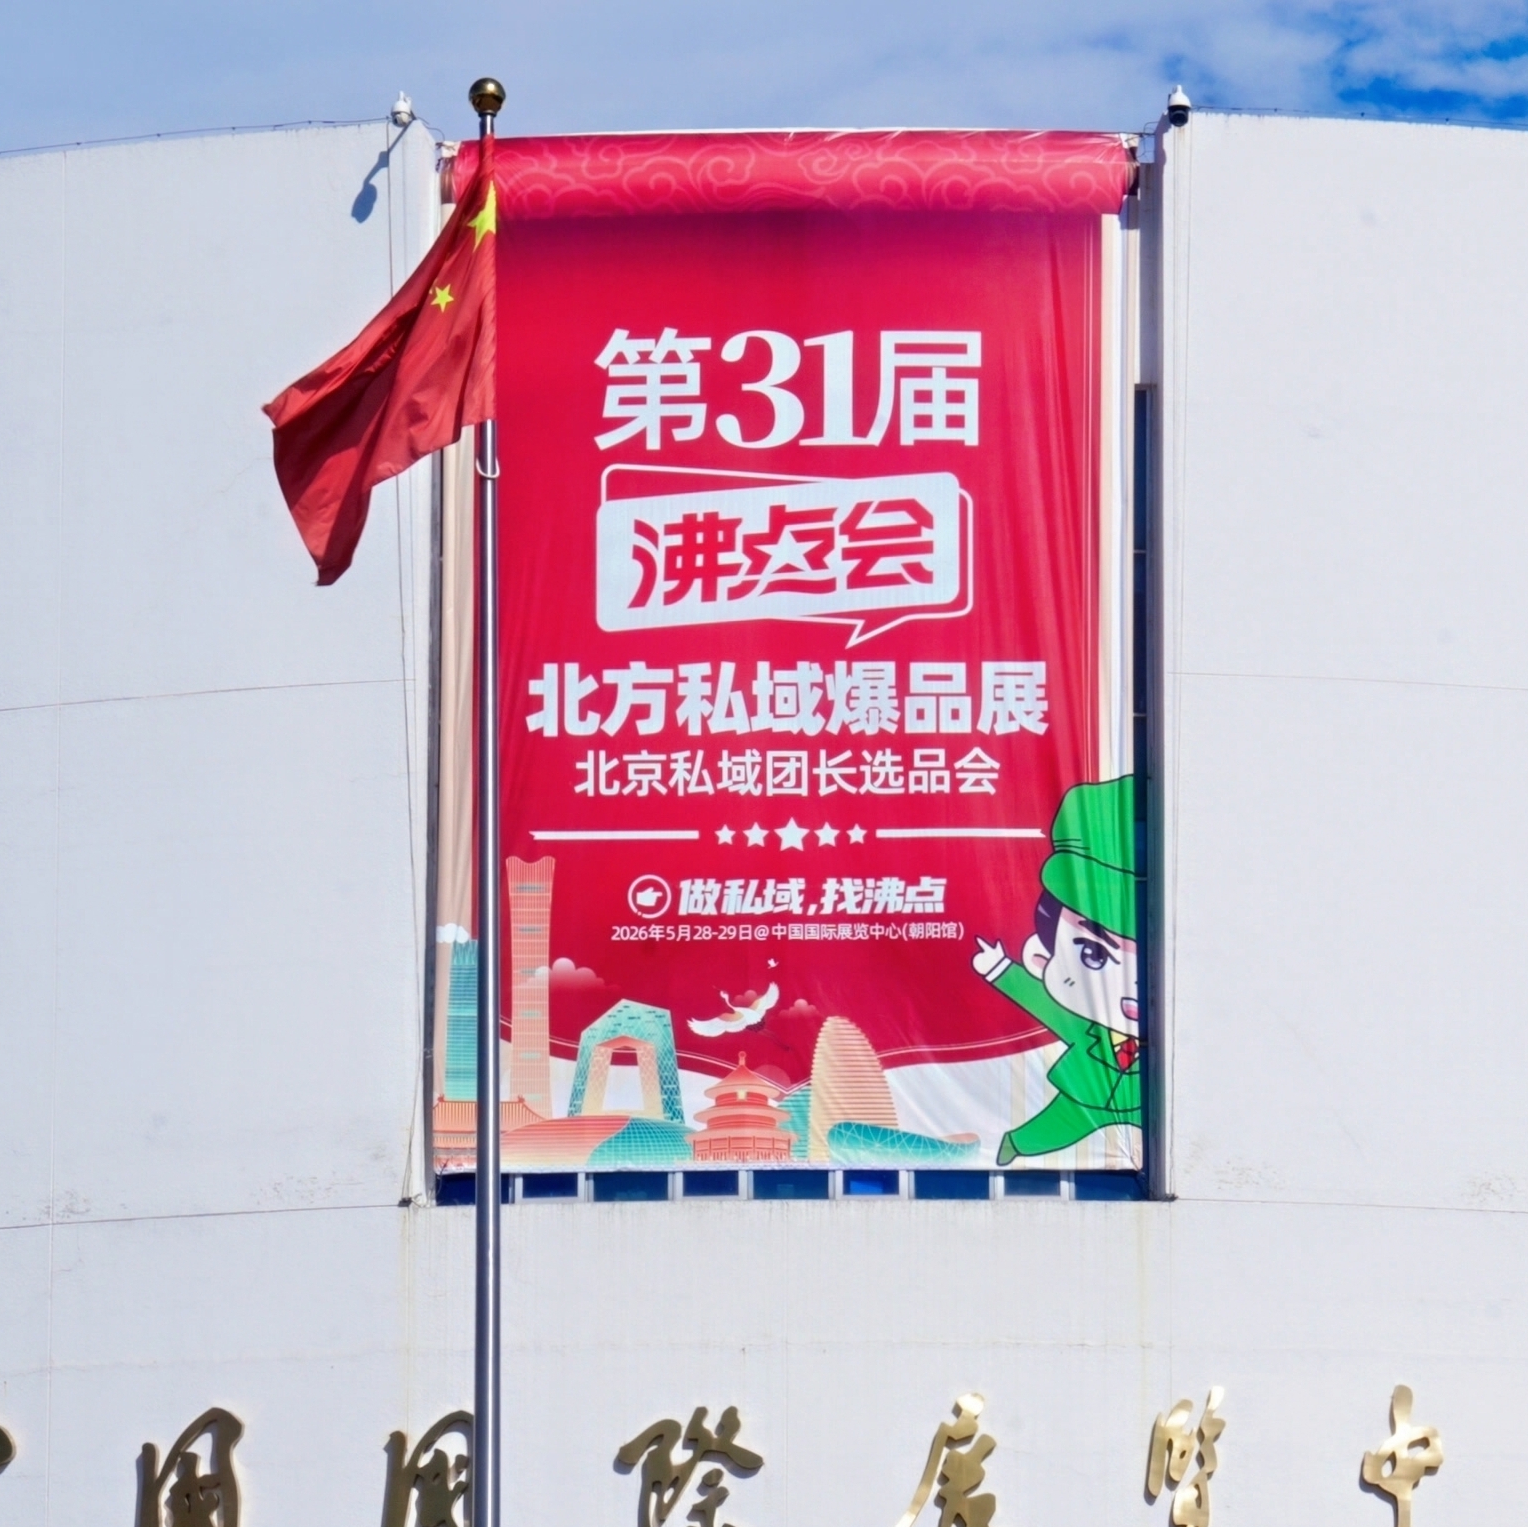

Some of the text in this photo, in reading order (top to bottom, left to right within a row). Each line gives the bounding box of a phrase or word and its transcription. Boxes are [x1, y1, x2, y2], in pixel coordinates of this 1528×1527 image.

[593, 327, 982, 451] 第31届
[628, 498, 935, 610] 沸点会
[525, 661, 1050, 738] 北方私域爆品展
[573, 747, 1001, 798] 北京私域团长选品会
